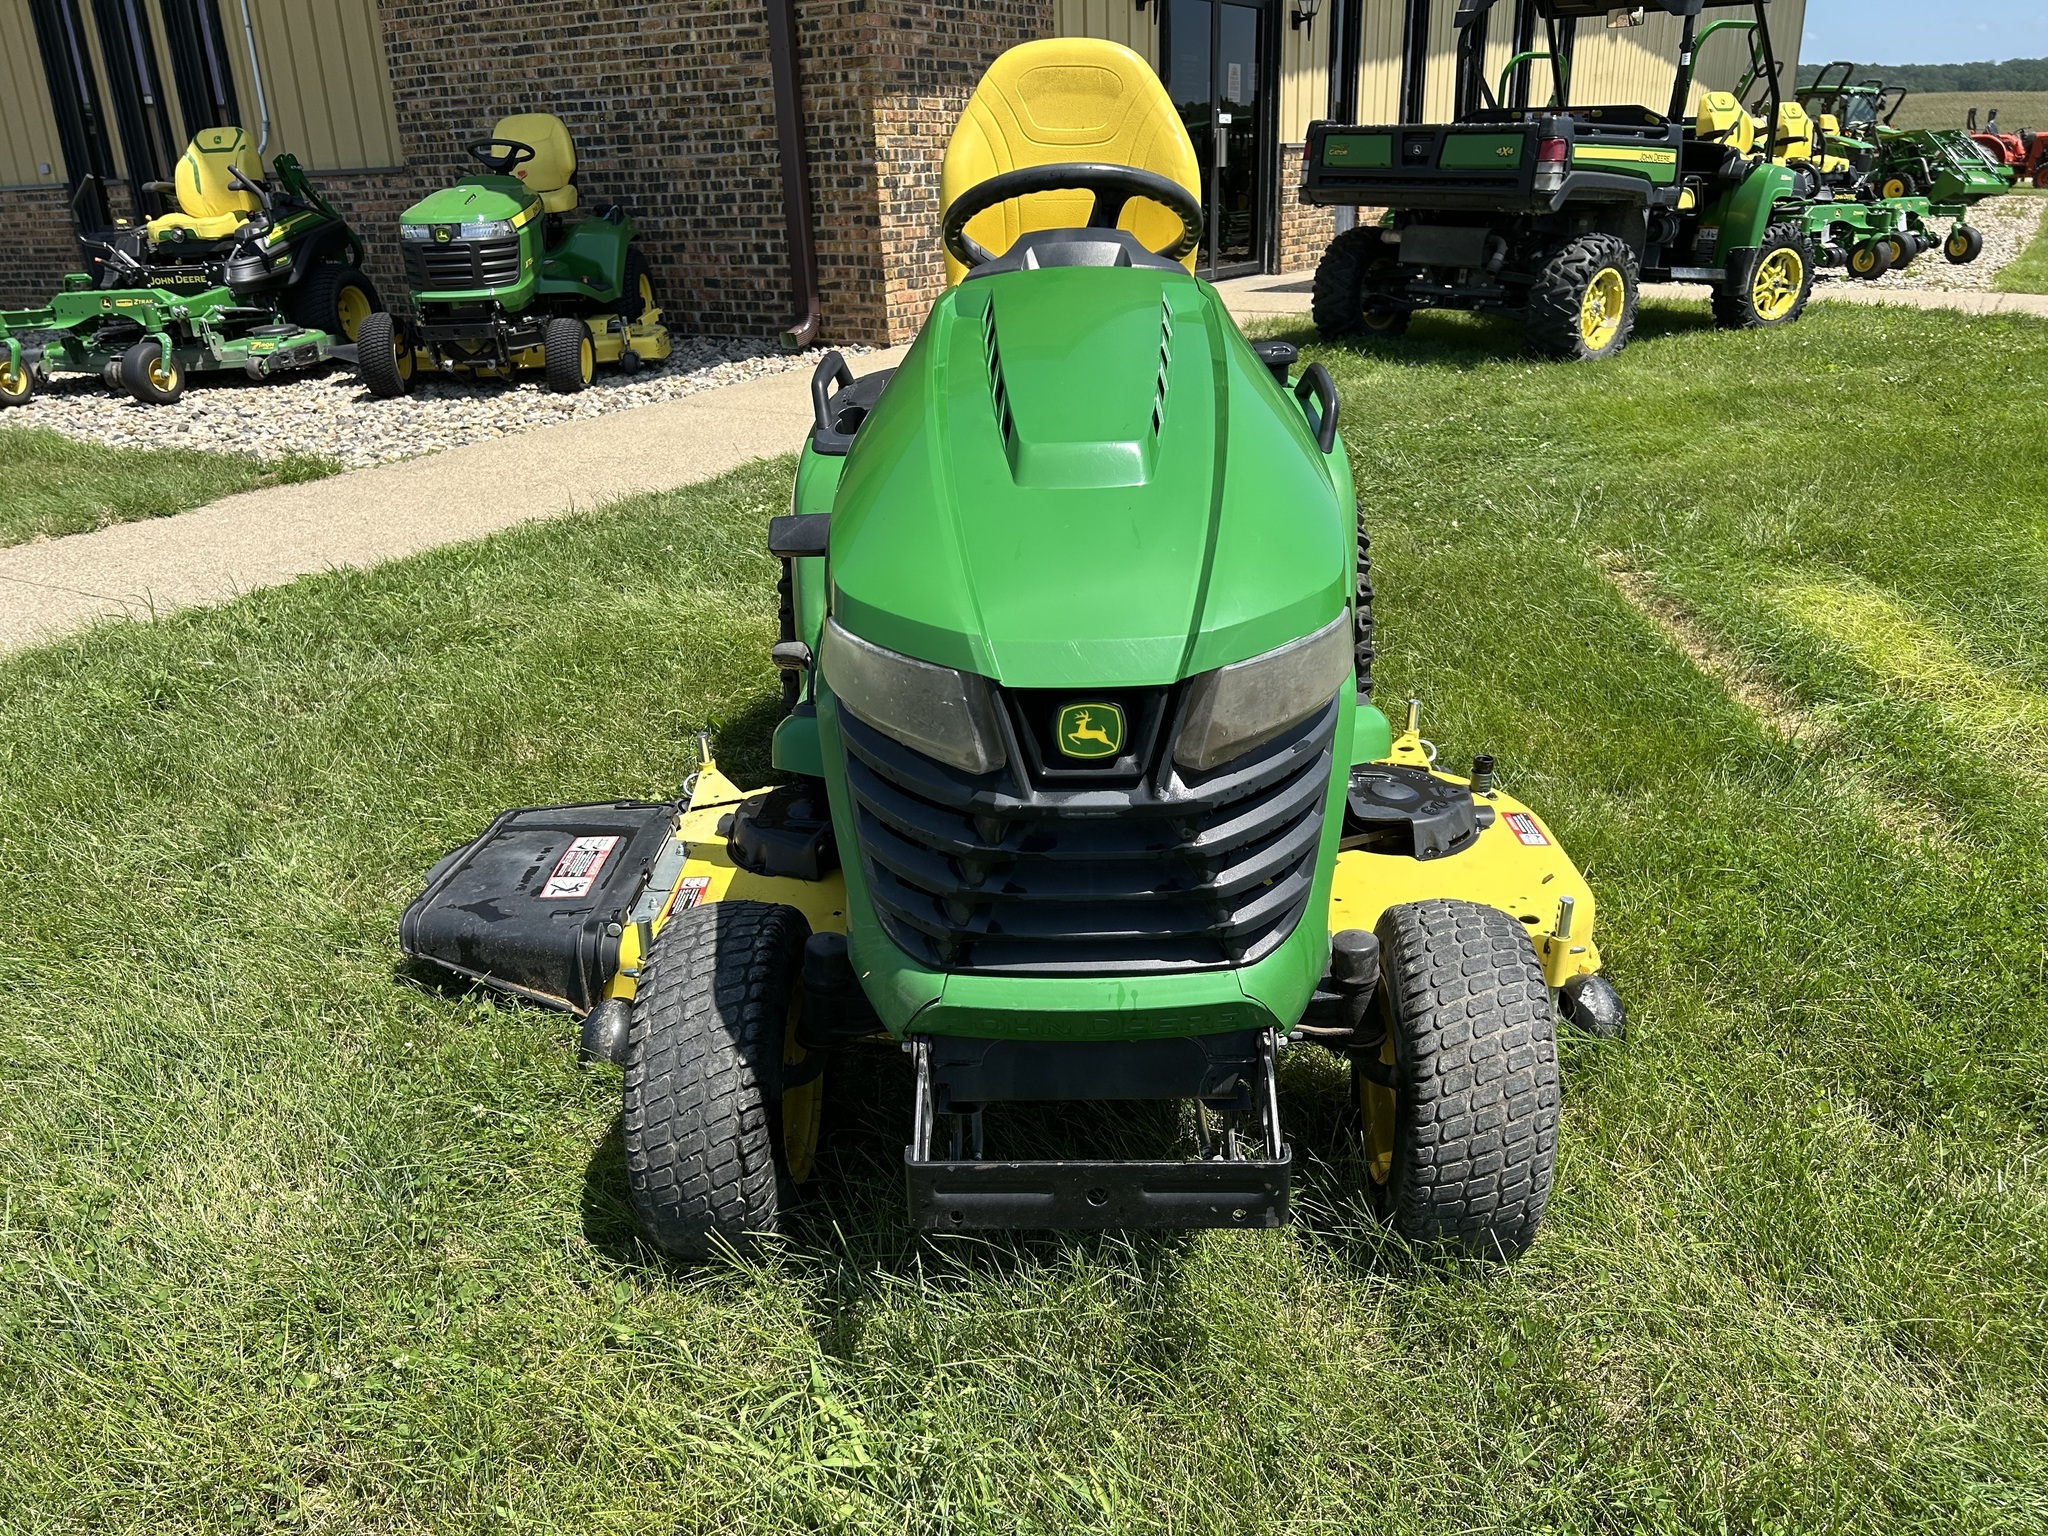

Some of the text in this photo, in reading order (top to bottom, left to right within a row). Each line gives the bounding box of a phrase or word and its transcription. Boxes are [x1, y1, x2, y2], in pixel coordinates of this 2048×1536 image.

[1496, 146, 1514, 156] 4X4
[1640, 152, 1671, 162] JOHN DEERE
[150, 275, 207, 285] JOHN DEERE
[948, 1011, 1241, 1037] JOHN DEERE
